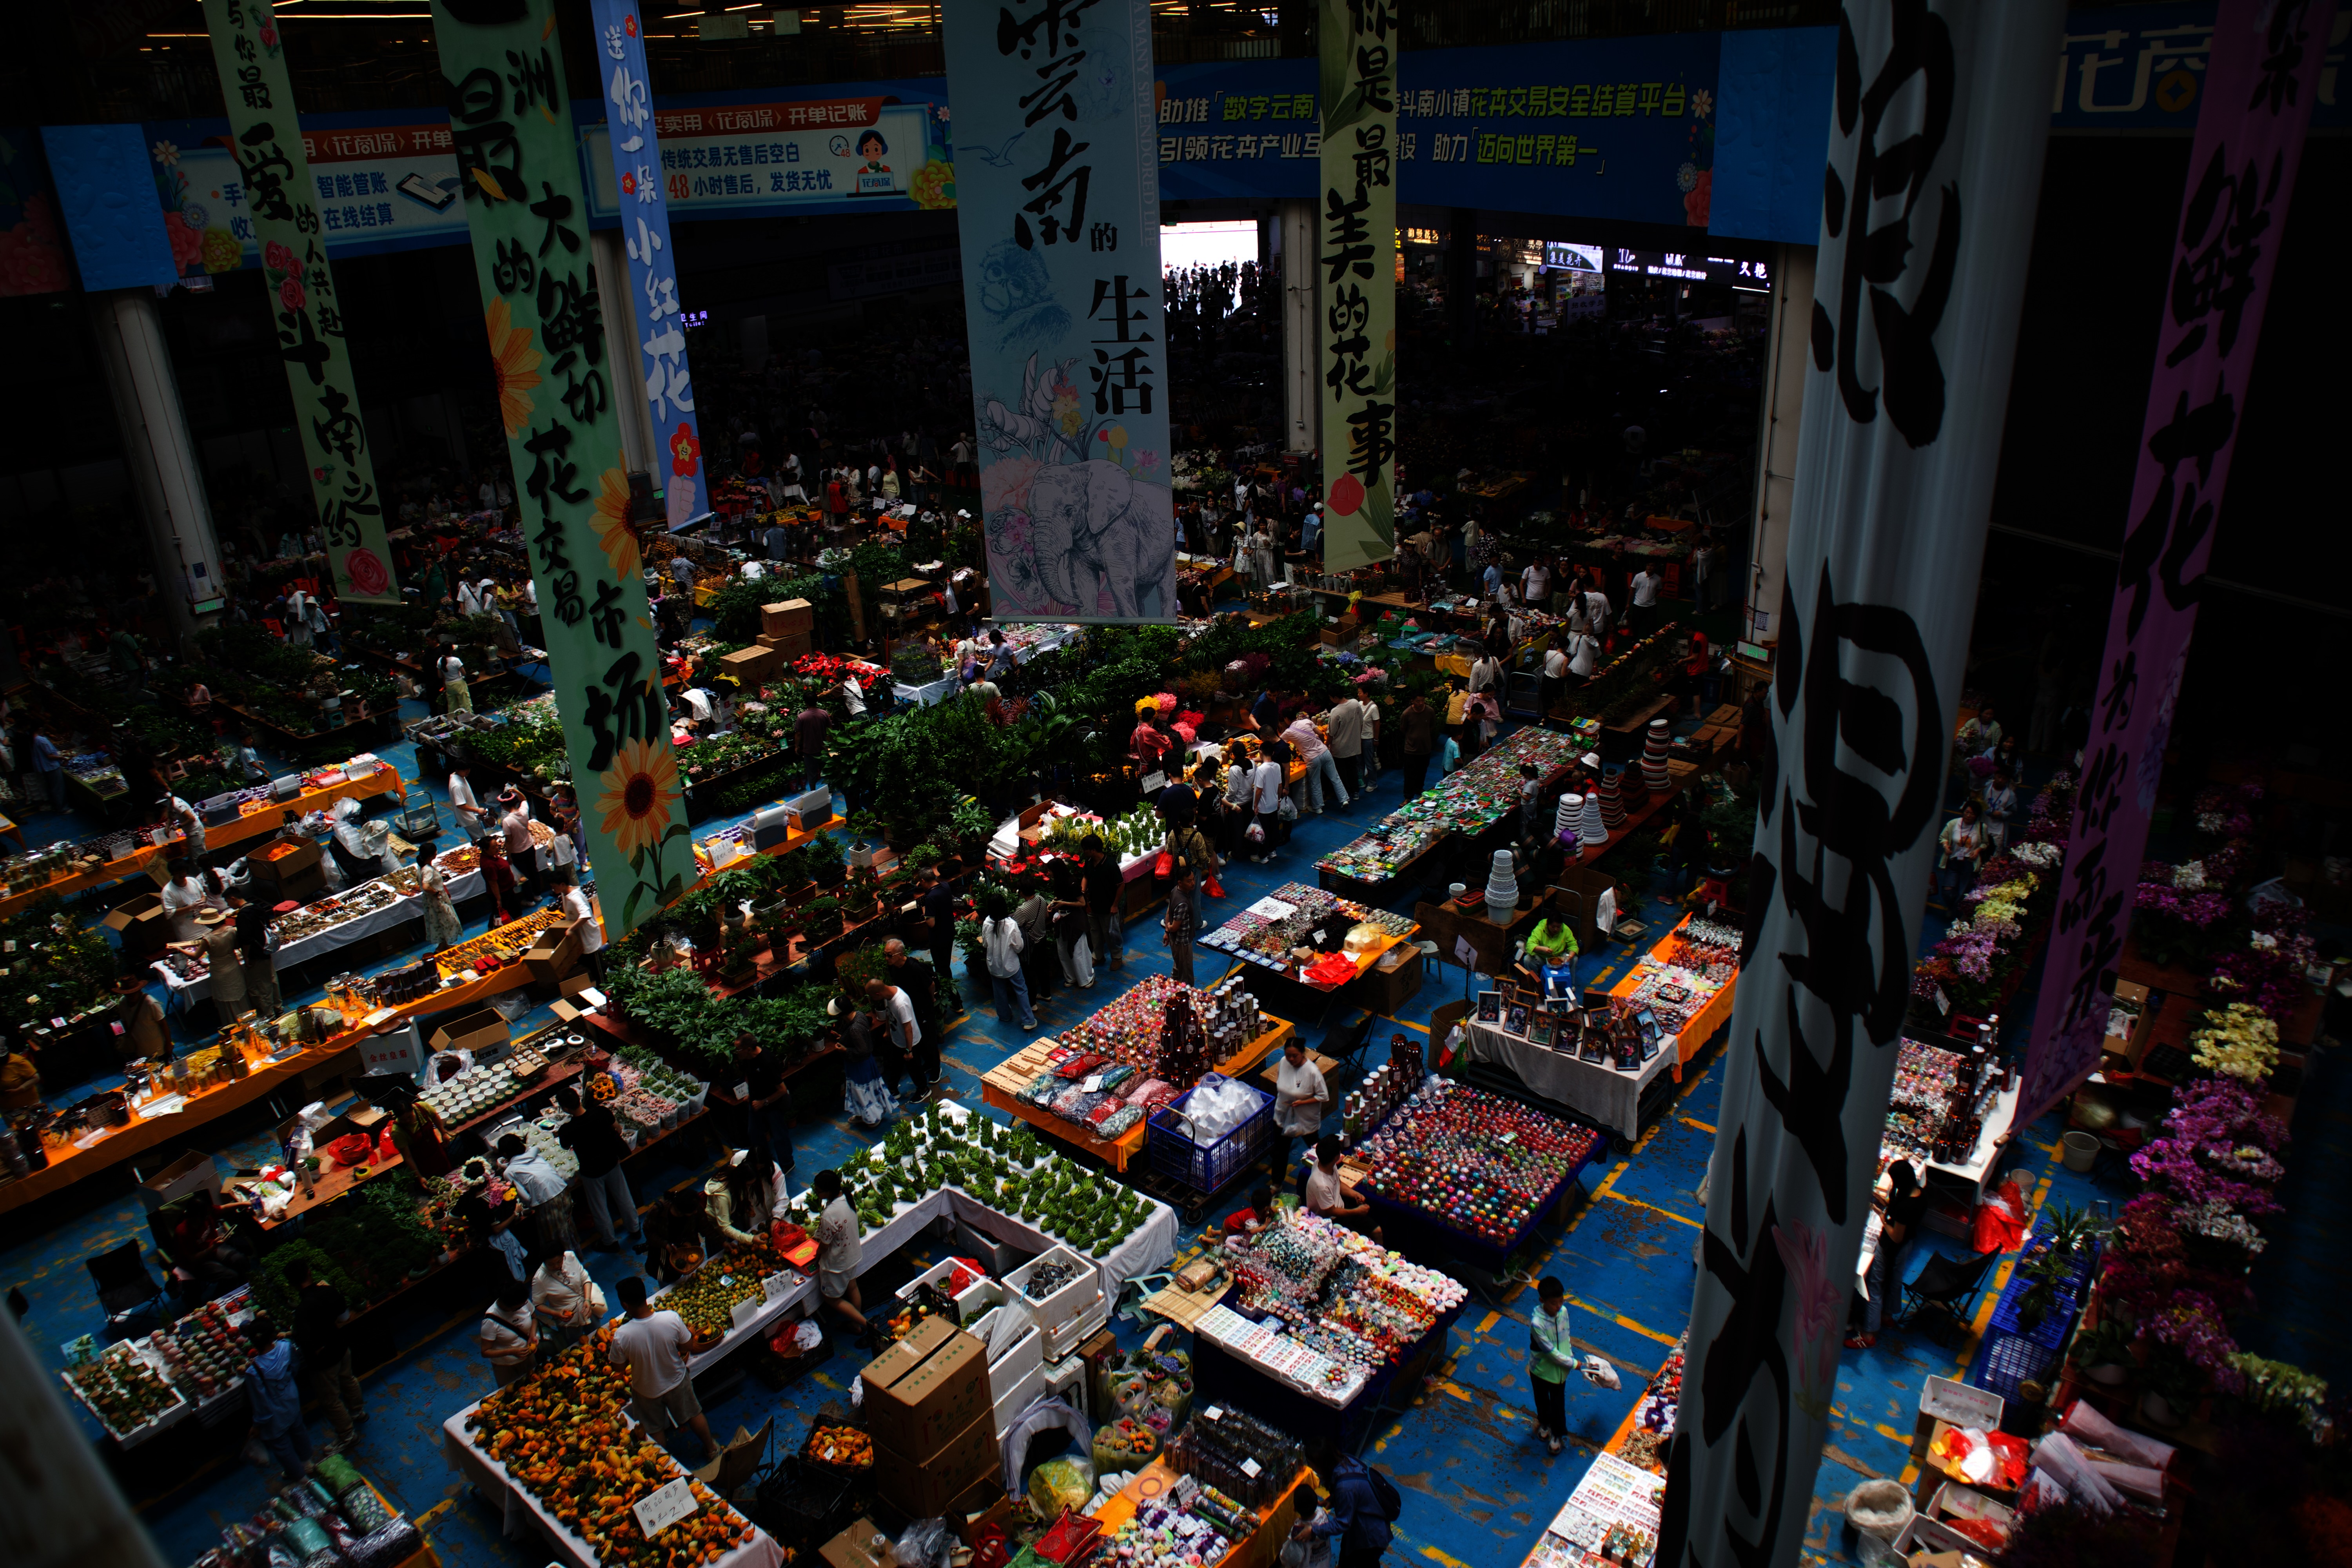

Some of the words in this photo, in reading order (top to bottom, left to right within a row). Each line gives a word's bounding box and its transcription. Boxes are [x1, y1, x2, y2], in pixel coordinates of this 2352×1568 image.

[1134, 19, 1149, 75] MANY
[1396, 82, 1687, 118] 斗南小镇花卉交易安全结算平台
[662, 142, 799, 170] 传统交易无售后空白
[841, 149, 850, 158] 48
[1138, 82, 1155, 205] SPLENDORED
[316, 171, 389, 199] 智能管账
[669, 174, 689, 199] 48
[862, 177, 891, 187] 花商保
[324, 202, 394, 232] 在线结算
[1146, 210, 1156, 248] LIFE
[857, 243, 904, 260] 斗南花市
[1549, 251, 1583, 267] 集美花卉
[1571, 298, 1604, 310] 招收学员
[684, 320, 705, 328] Toilet
[442, 0, 660, 771] 洲最大的鲜切花交易市场
[780, 617, 806, 629] 文心兰
[370, 1049, 408, 1063] 金丝皇菊
